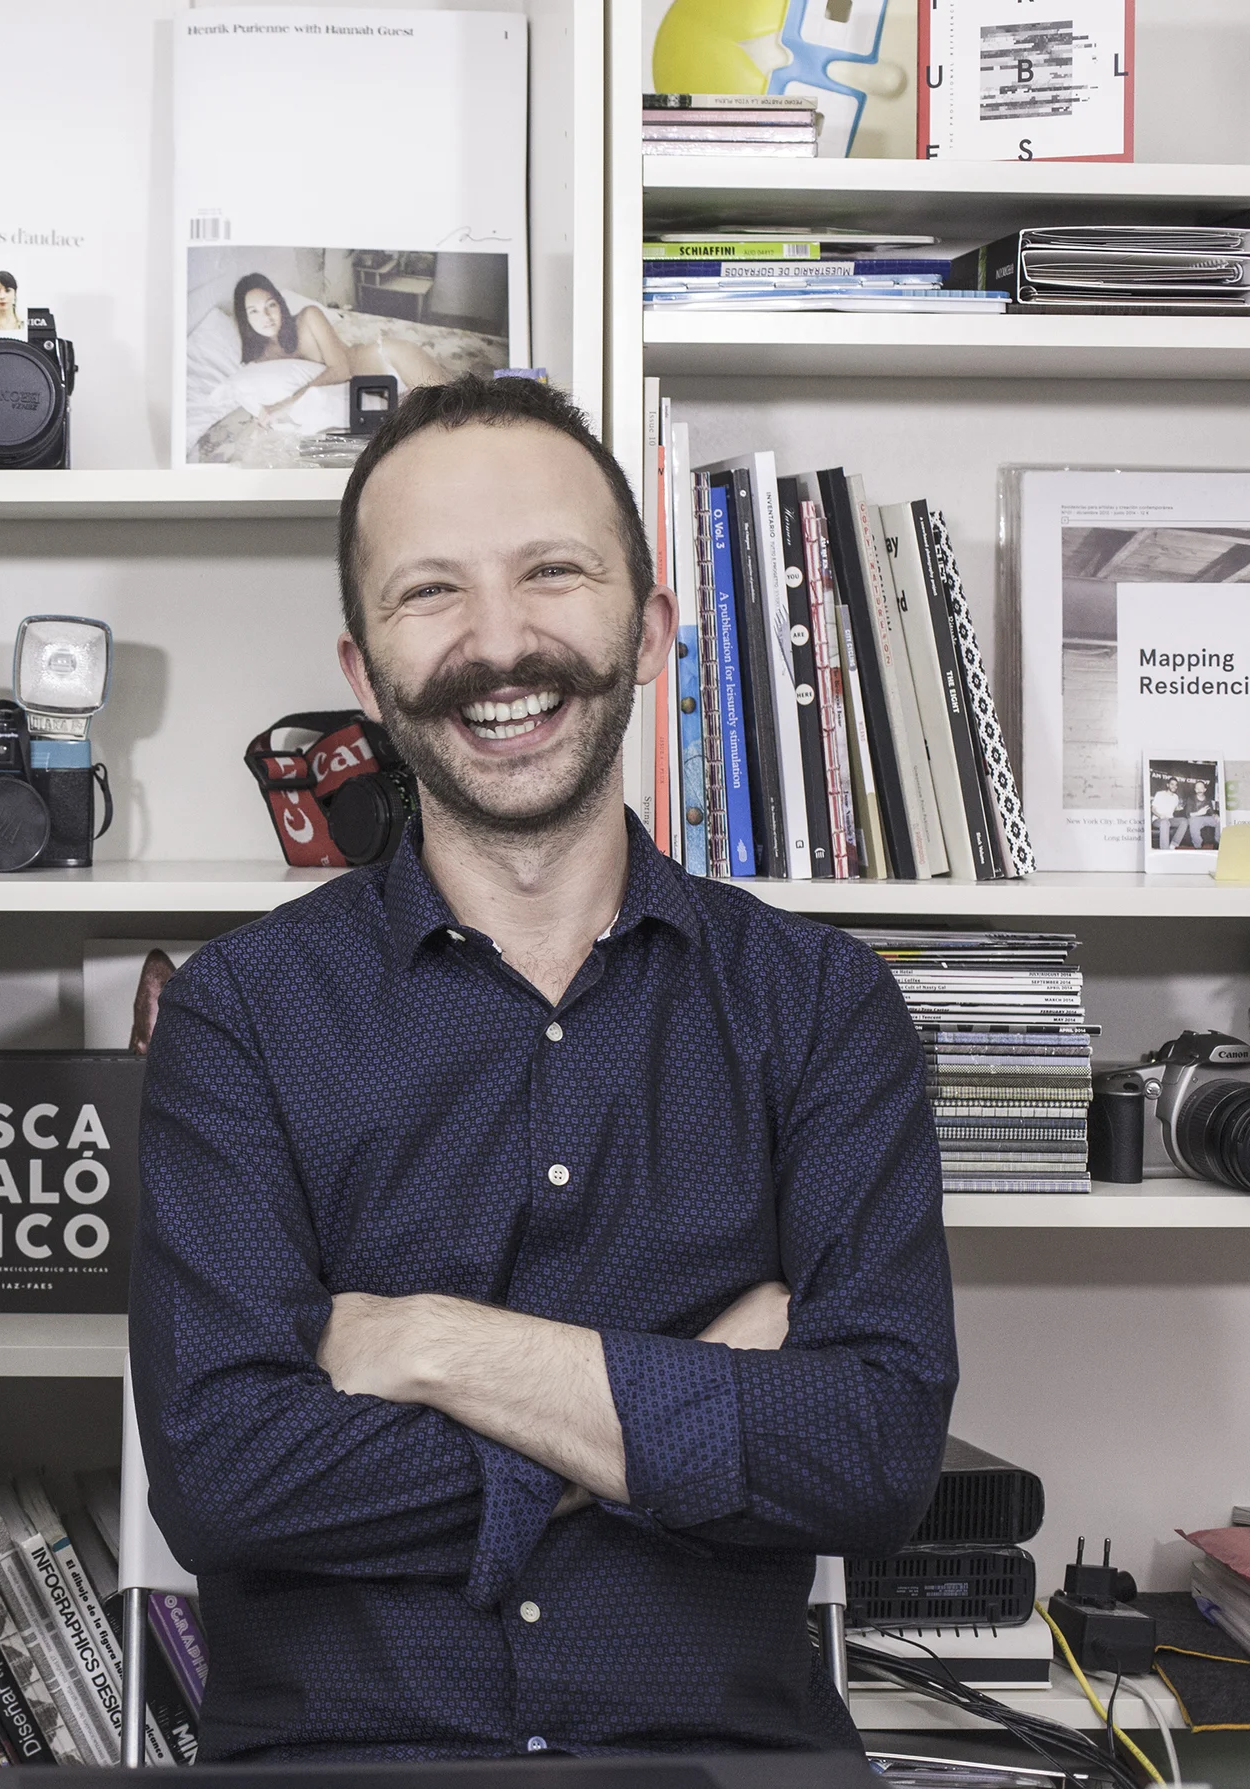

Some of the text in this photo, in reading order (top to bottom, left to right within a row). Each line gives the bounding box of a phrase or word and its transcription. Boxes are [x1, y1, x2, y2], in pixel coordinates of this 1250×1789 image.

[187, 23, 415, 38] Henrik Purienne with Hannah Guest
[1017, 59, 1035, 83] B
[1113, 53, 1129, 77] L
[1017, 139, 1034, 162] S
[679, 246, 736, 257] SCHIAFFINI
[724, 266, 852, 277] MUESTRARIO DE GOFRADOS
[648, 411, 657, 446] Issue 10
[766, 491, 776, 538] INVENTARIO
[713, 523, 725, 542] Vol.
[719, 603, 733, 663] publication
[1139, 648, 1235, 672] Mapping
[724, 665, 734, 682] for
[1139, 675, 1250, 695] Residenci
[946, 670, 960, 714] THE EIGHT
[725, 683, 738, 728] leisurely
[729, 729, 742, 790] stimulation
[644, 796, 653, 826] Spring
[1066, 818, 1081, 826] New
[1083, 818, 1099, 826] York
[1218, 1050, 1249, 1060] Canon
[82, 1266, 109, 1274] CACAS
[31, 1546, 100, 1673] INFOGRAPHICS
[65, 1559, 117, 1662] El dibujo de la figura
